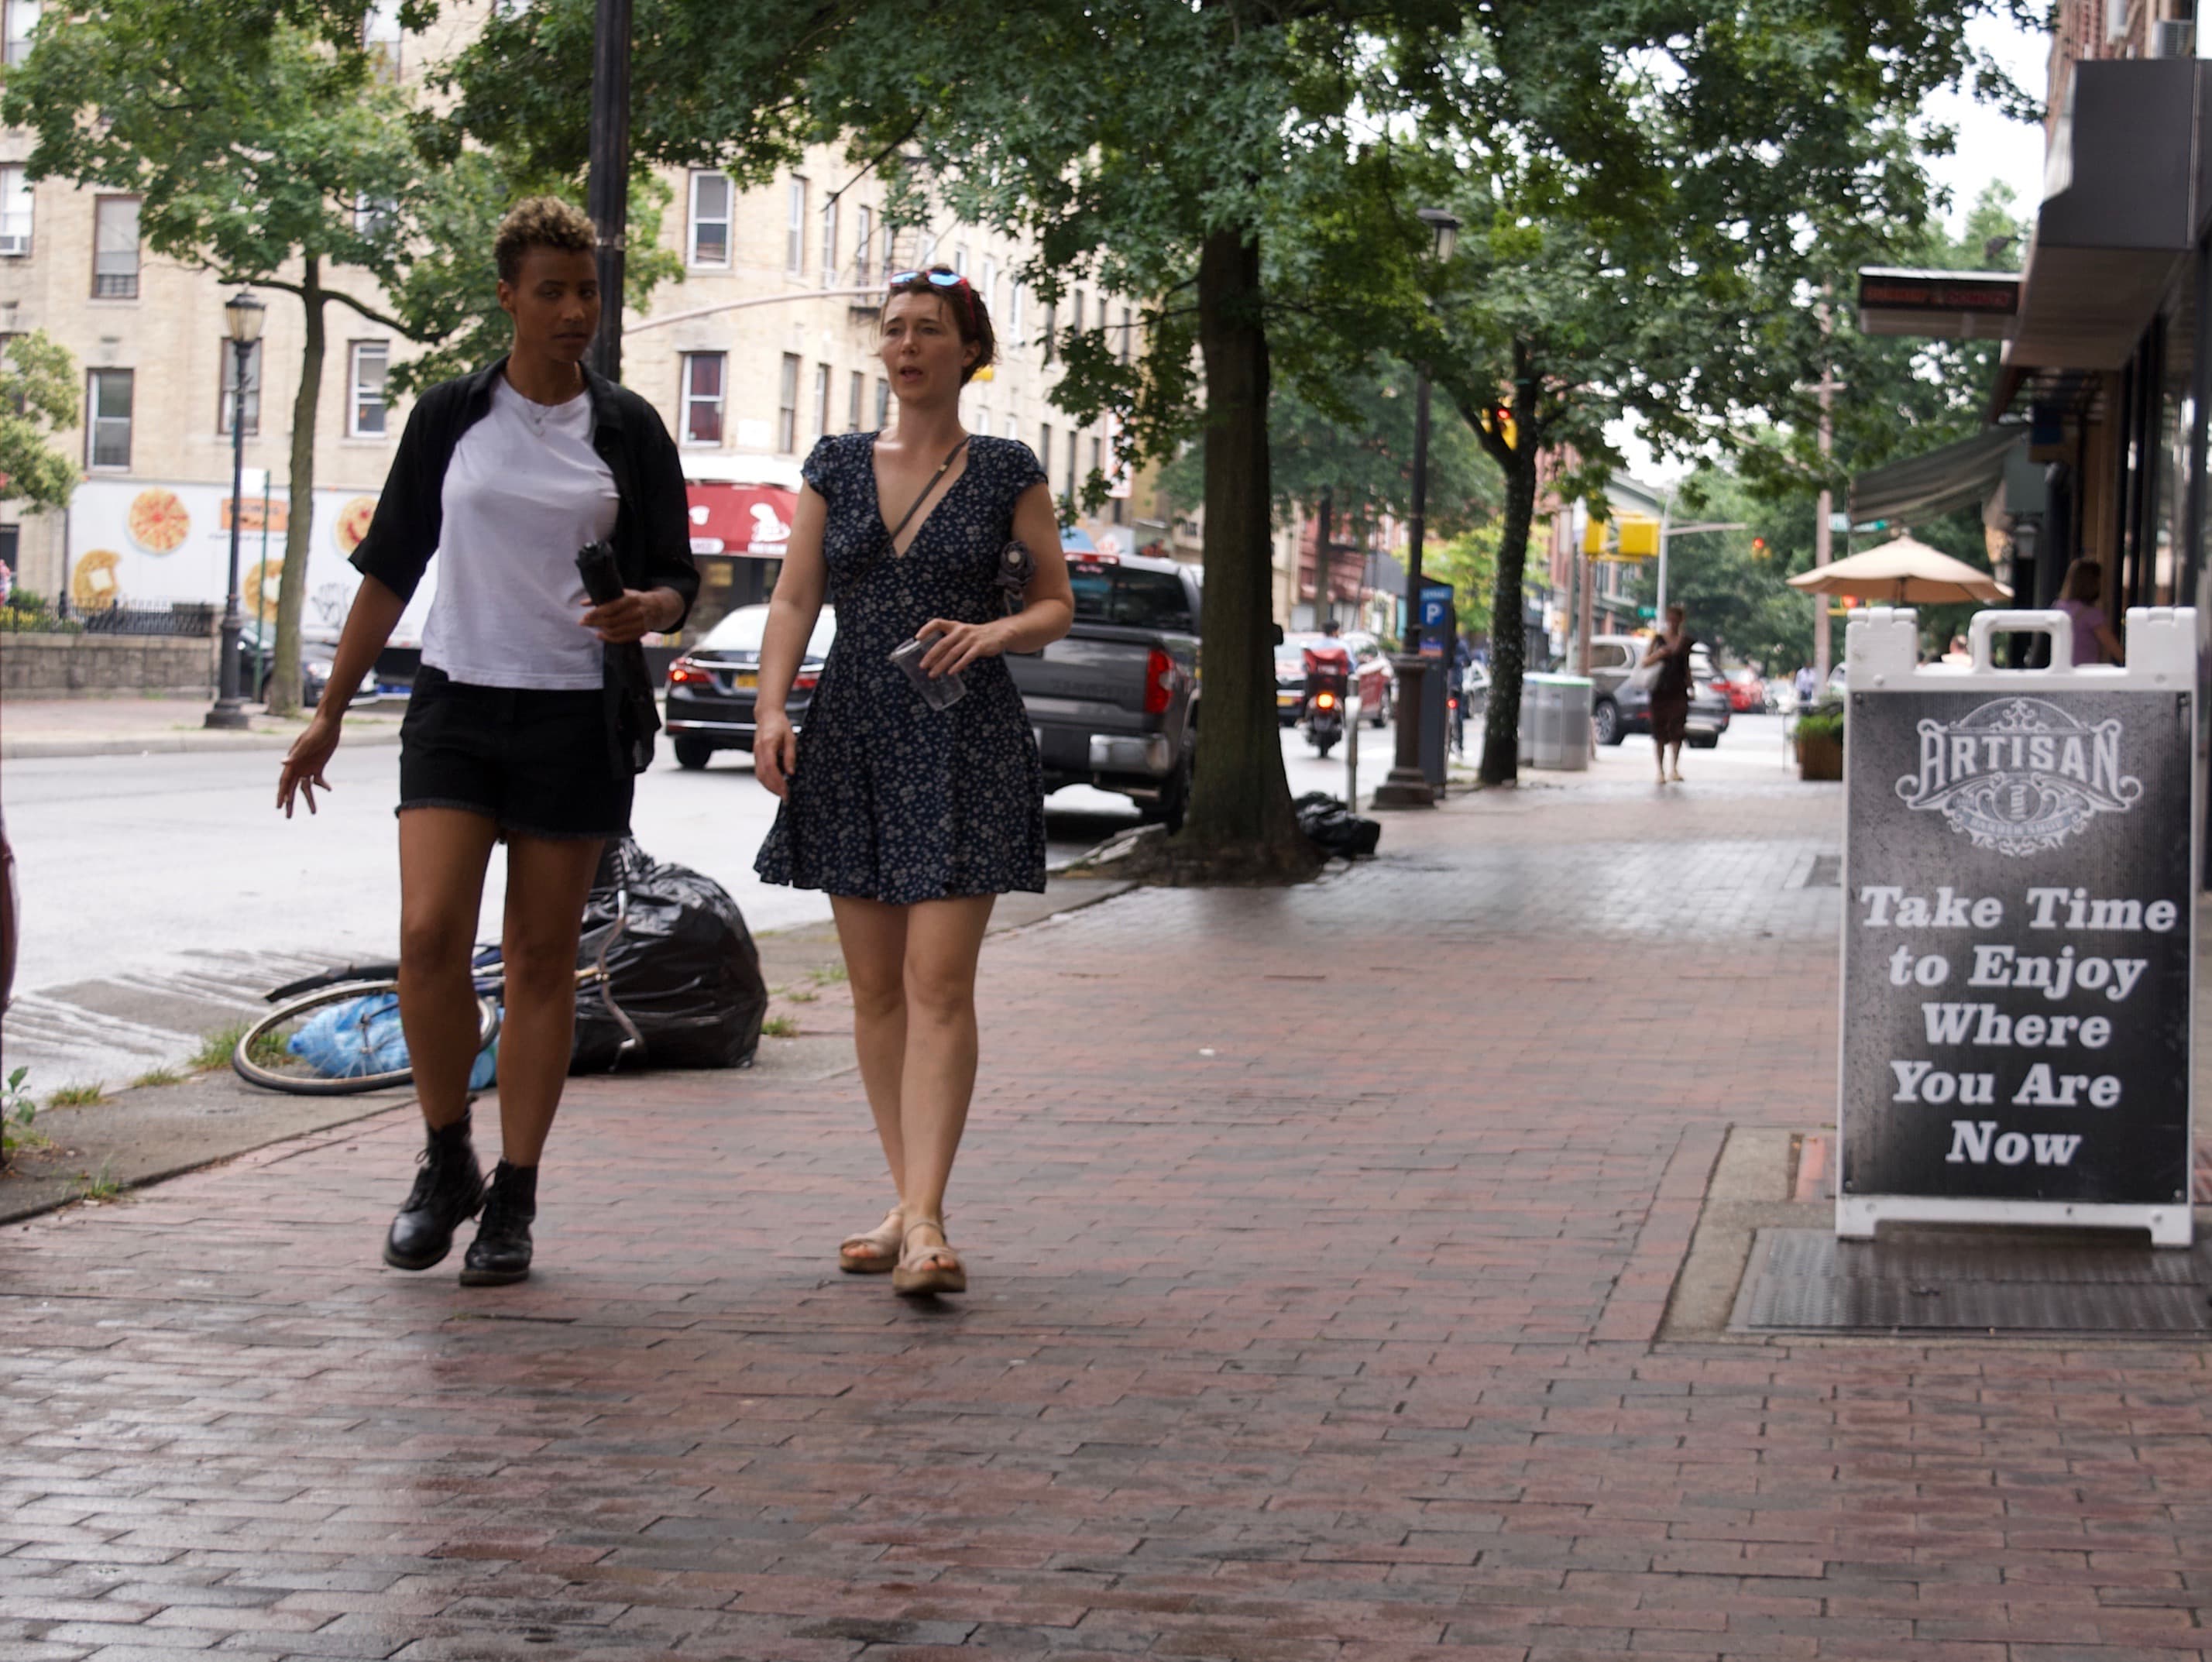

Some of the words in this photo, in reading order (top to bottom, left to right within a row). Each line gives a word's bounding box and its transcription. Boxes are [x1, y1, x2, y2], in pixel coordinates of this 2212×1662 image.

[1427, 603, 1443, 624] P
[1904, 719, 2136, 798] ARTISAN
[1860, 885, 2004, 929] Take
[2025, 887, 2176, 932] Time
[1889, 945, 1950, 986] to
[1966, 945, 2148, 1001] Enjoy
[1920, 1001, 2111, 1048] Where
[1890, 1059, 1994, 1104] You
[2011, 1063, 2121, 1107] Are
[1945, 1121, 2081, 1165] Now
